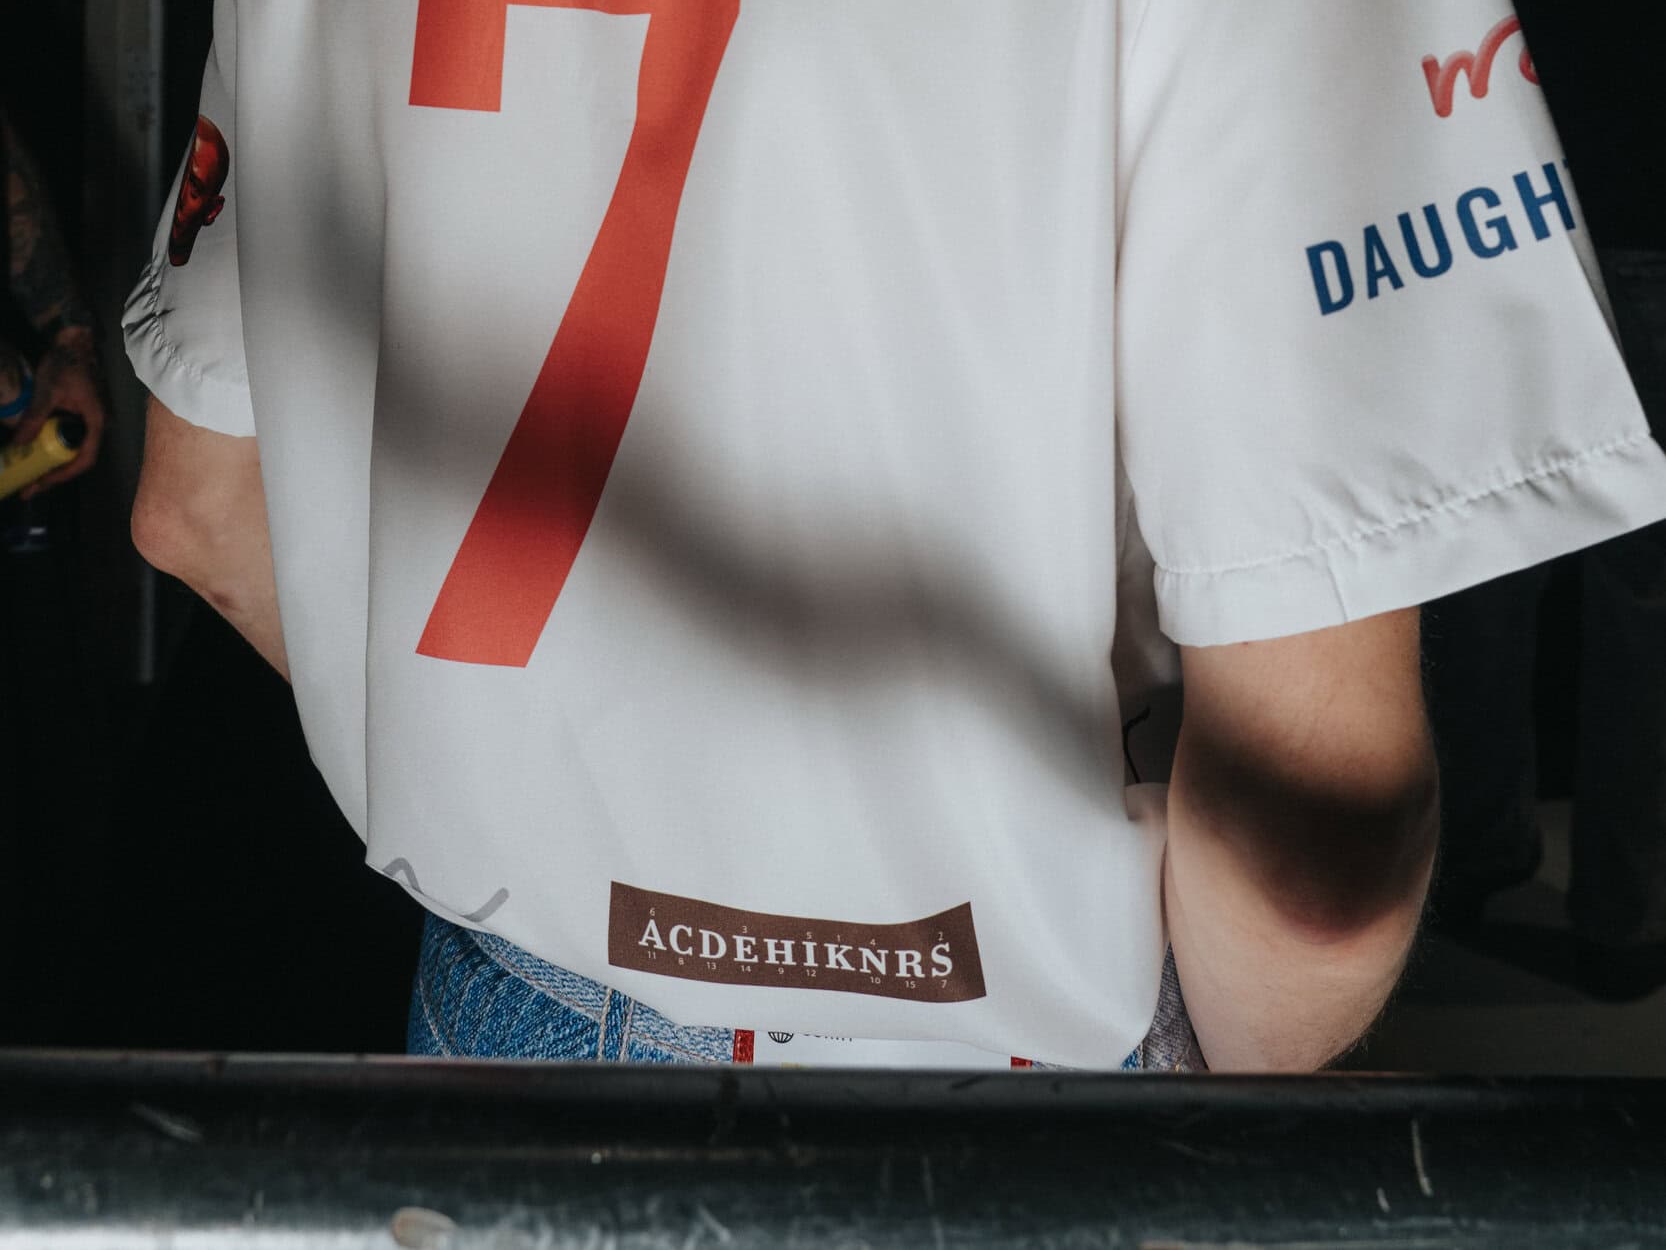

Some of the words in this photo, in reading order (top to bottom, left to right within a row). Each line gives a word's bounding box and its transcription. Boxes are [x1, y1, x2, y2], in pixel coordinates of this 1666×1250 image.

[1305, 157, 1576, 316] DAUGH
[649, 907, 656, 918] 6
[741, 925, 748, 934] 3
[869, 938, 877, 947] 4
[937, 931, 944, 942] 2
[647, 950, 658, 961] 11
[677, 957, 685, 967] 8
[706, 961, 718, 971] 13
[740, 964, 752, 974] 14
[777, 967, 785, 976] 9
[805, 969, 817, 978] 12
[869, 976, 882, 985] 10
[905, 979, 917, 989] 15
[941, 979, 948, 989] 7
